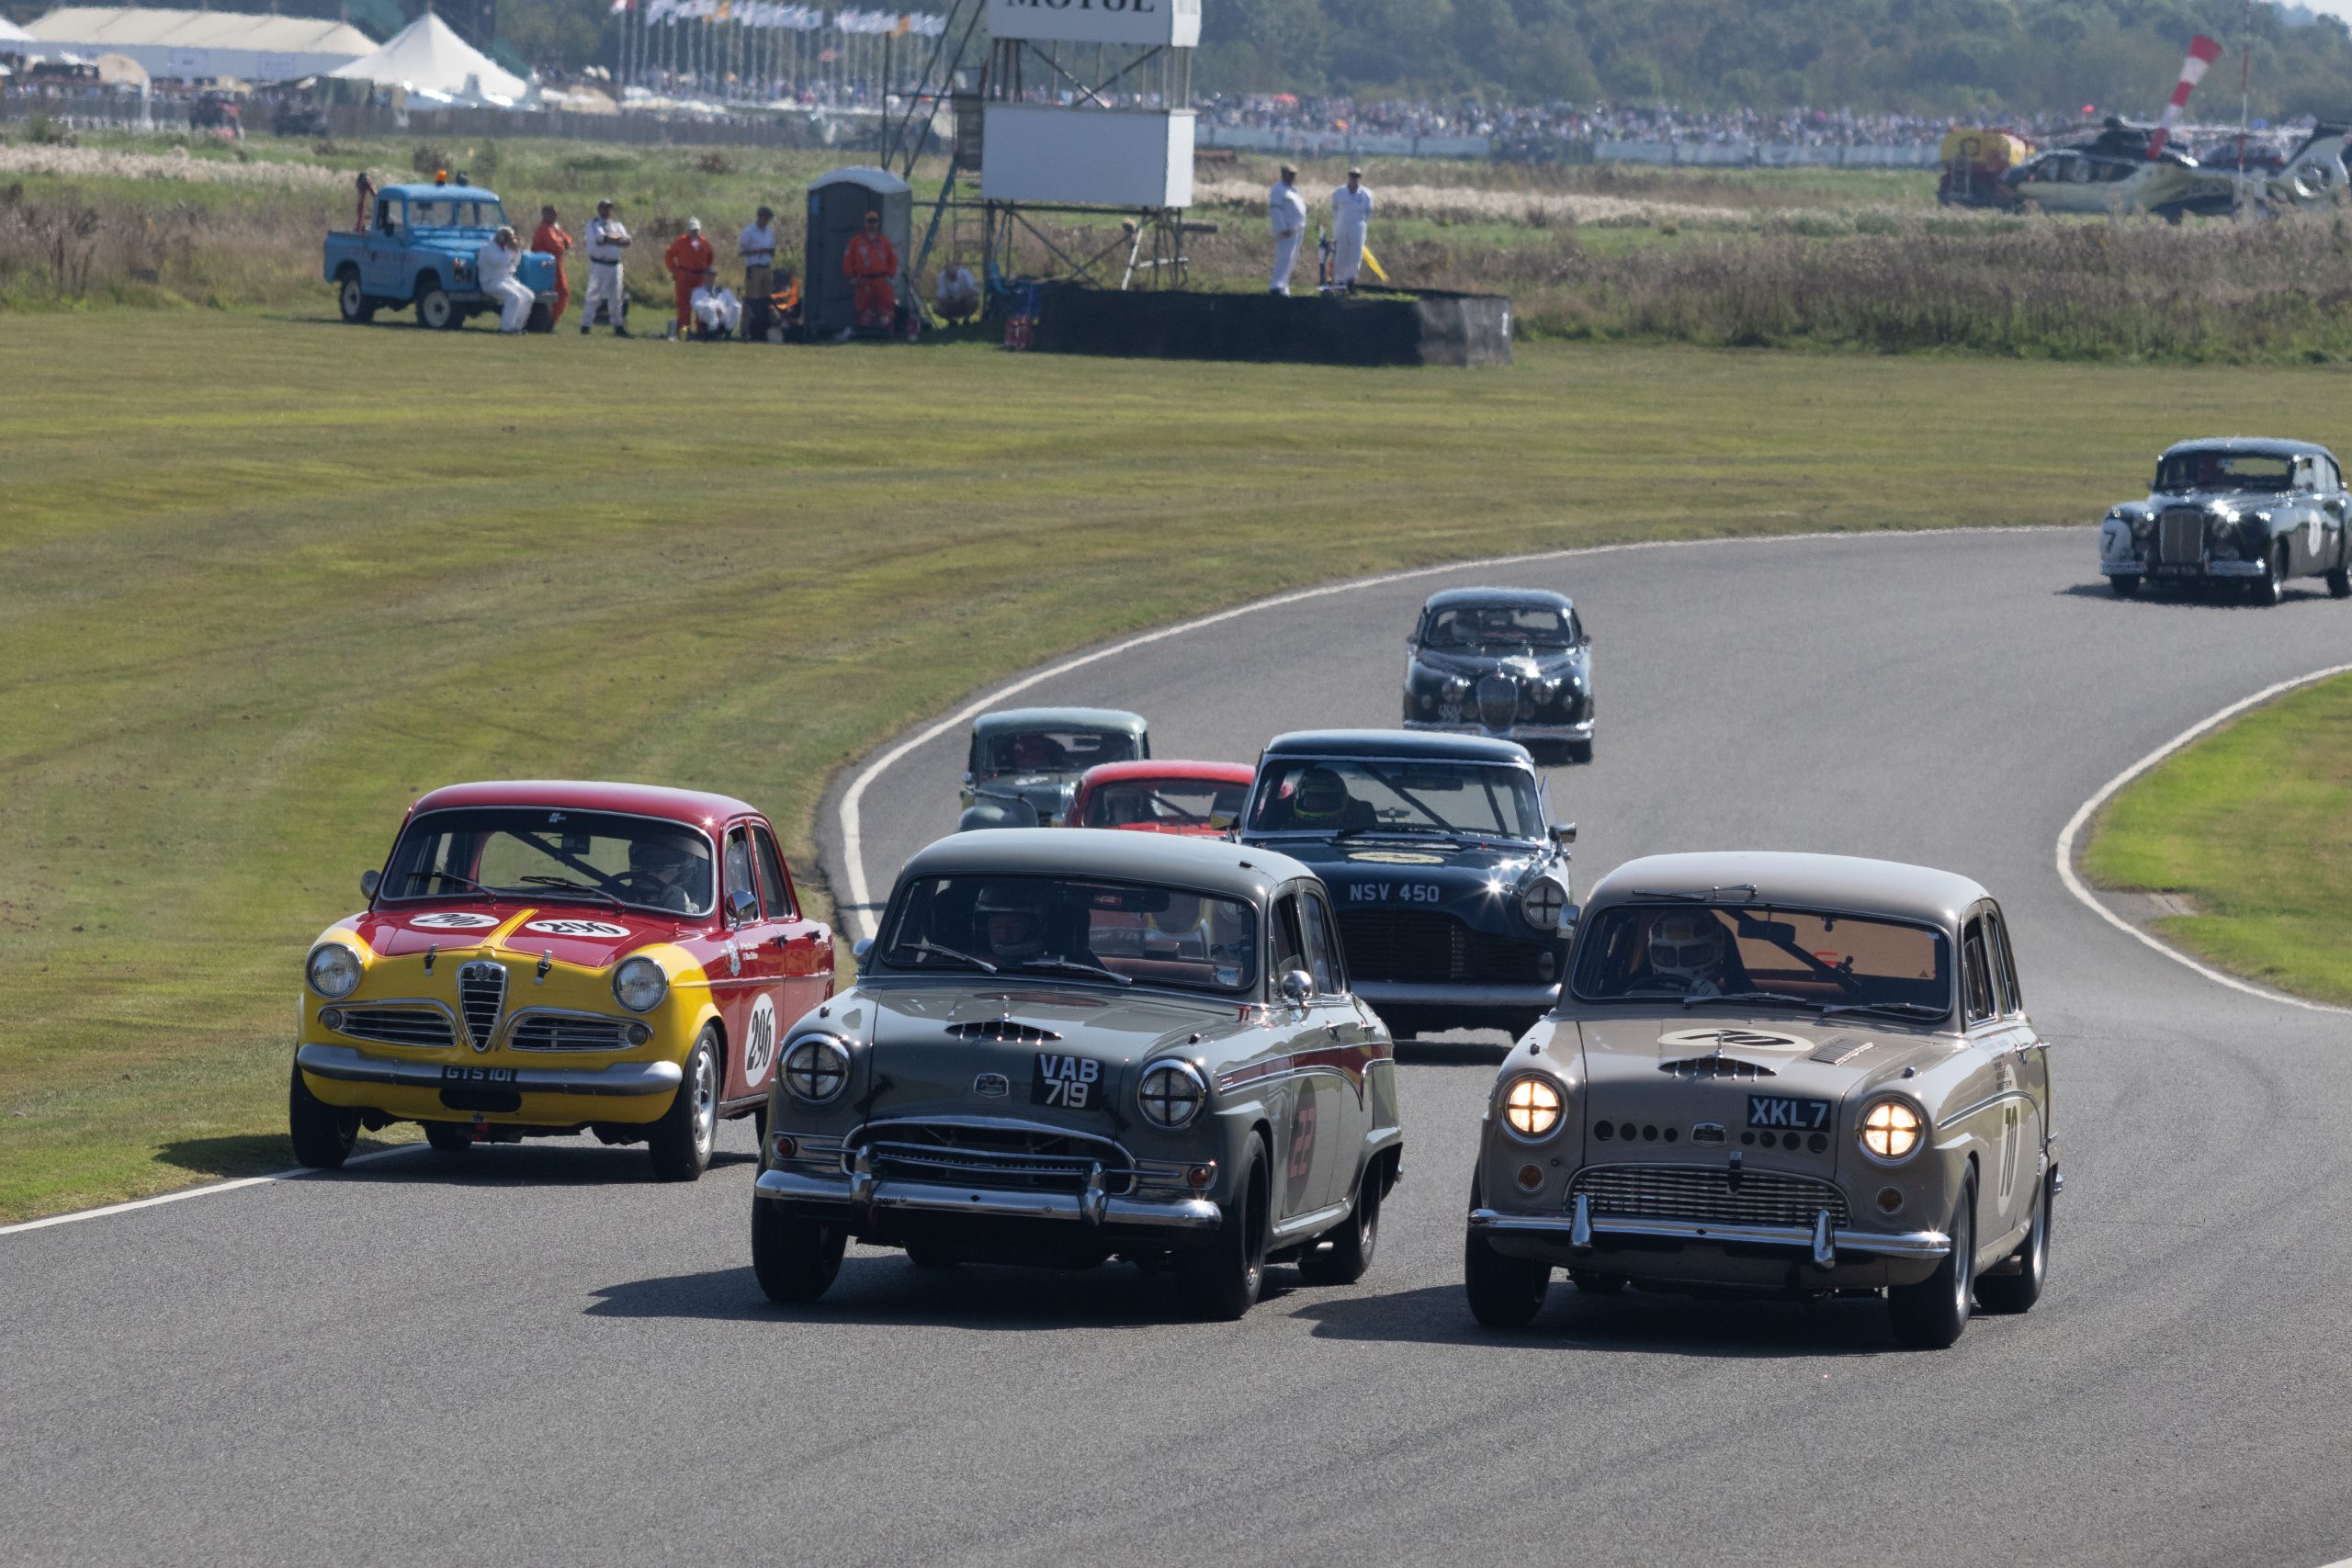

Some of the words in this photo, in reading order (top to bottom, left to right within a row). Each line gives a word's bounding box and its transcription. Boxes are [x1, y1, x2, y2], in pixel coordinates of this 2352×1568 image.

[1350, 884, 1390, 901] NSV
[1399, 884, 1440, 902] 450
[535, 921, 621, 935] 296
[746, 1007, 773, 1071] 296
[447, 1066, 484, 1079] GTS
[489, 1068, 512, 1082] 101
[1040, 1055, 1099, 1083] VAB
[1045, 1078, 1089, 1109] 719
[1289, 1108, 1316, 1179] 22
[1999, 1105, 2018, 1197] 70
